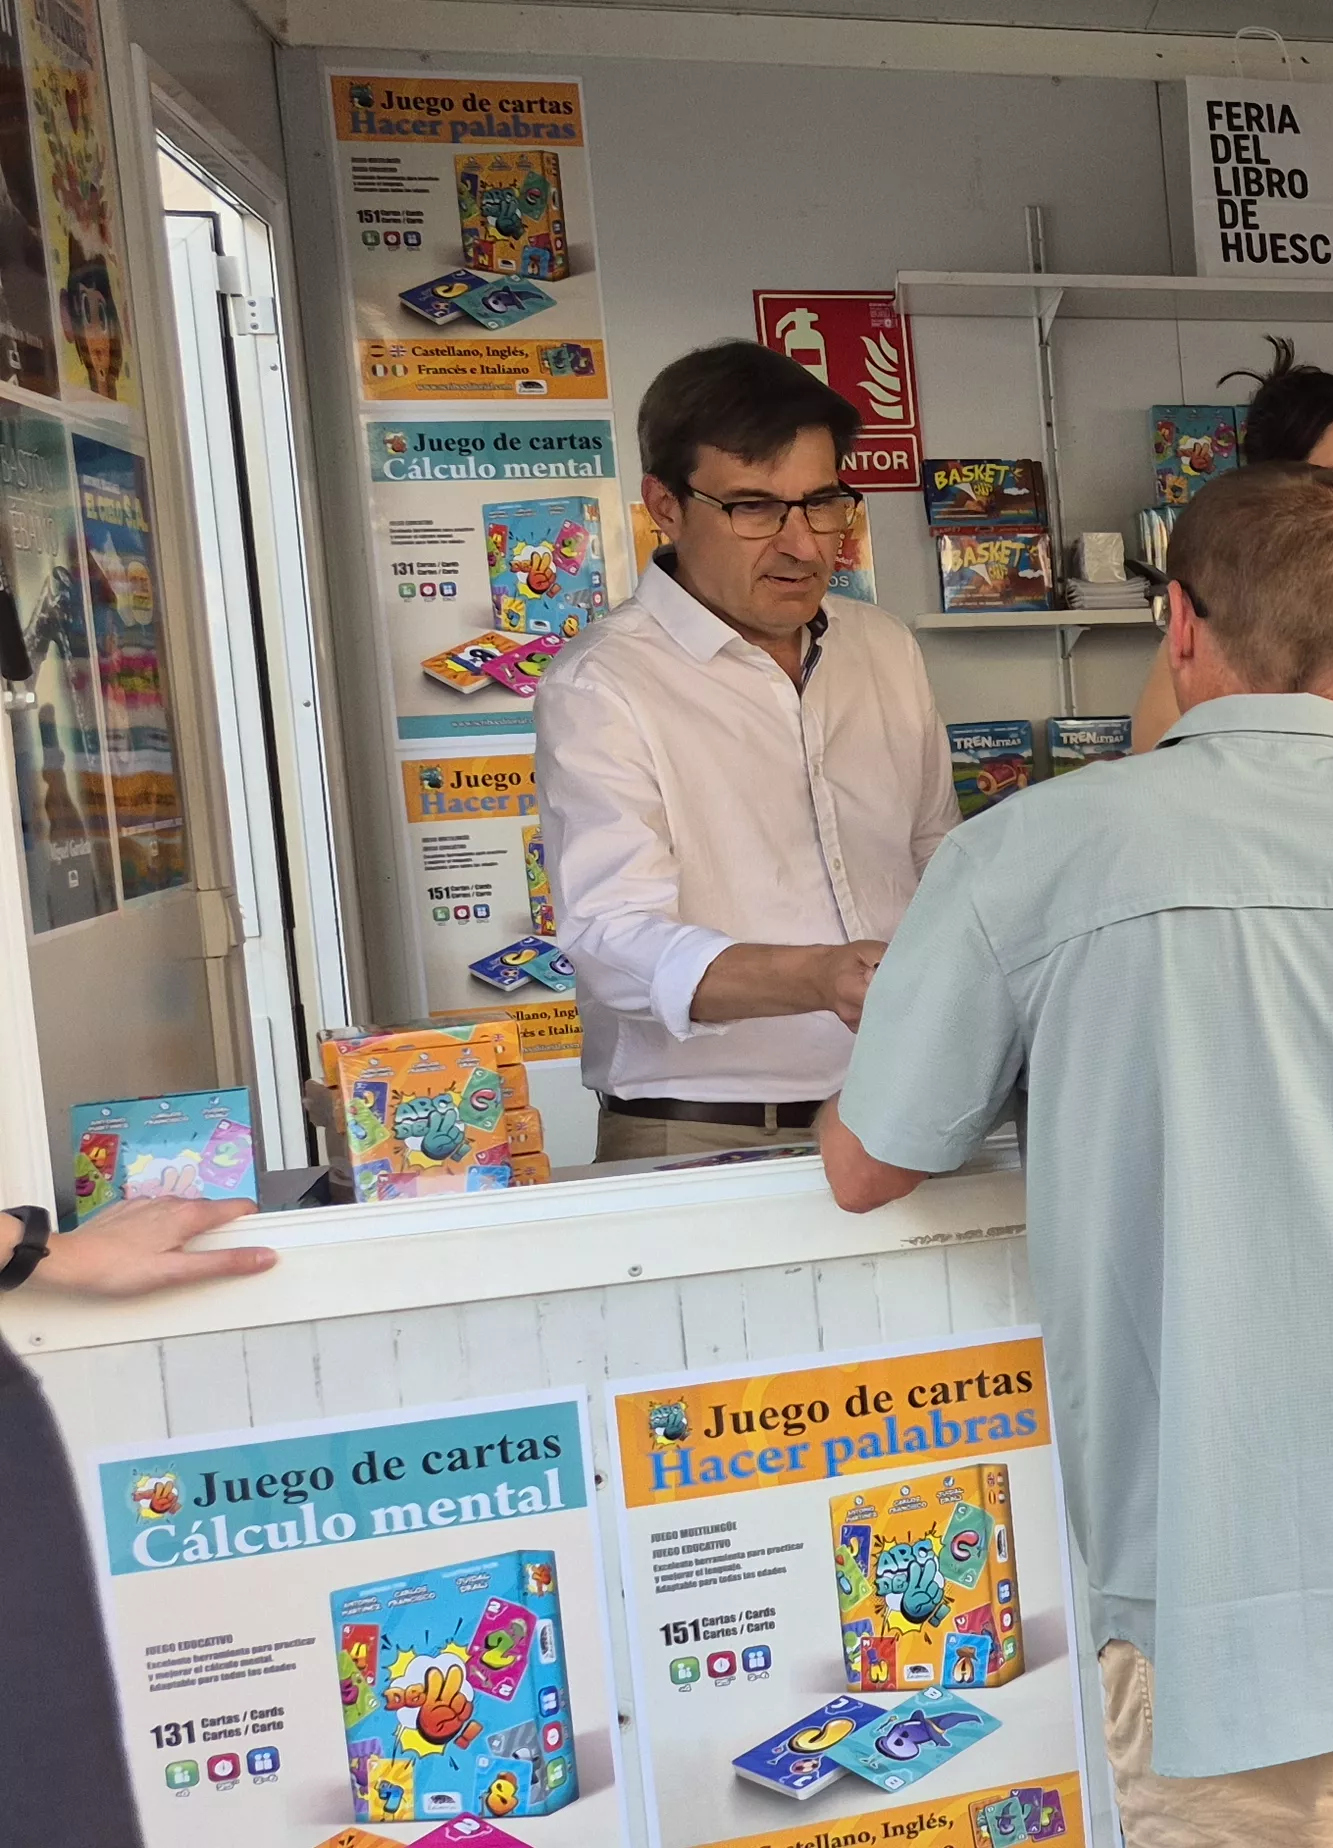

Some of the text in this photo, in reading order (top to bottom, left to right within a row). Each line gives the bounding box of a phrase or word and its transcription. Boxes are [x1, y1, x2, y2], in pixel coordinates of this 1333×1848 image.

[381, 90, 573, 115] Juego de cartas
[350, 111, 577, 143] Hacer palabras
[1206, 100, 1301, 134] FERIA
[1210, 133, 1271, 165] DEL
[1214, 166, 1309, 199] LIBRO
[356, 209, 380, 223] 151
[1217, 198, 1260, 230] DE
[411, 345, 529, 361] Castellano, Inglés,
[418, 363, 467, 375] Francés
[480, 364, 529, 375] Italiano
[413, 433, 602, 456] Juego de cartas
[383, 454, 604, 480] Cálculo mental
[841, 451, 909, 470] NTOR
[934, 463, 1009, 490] BASKET
[951, 540, 1026, 572] BASKET
[391, 562, 414, 576] 131
[953, 735, 994, 750] TREN
[1060, 731, 1097, 745] TREN
[451, 770, 521, 791] Juego
[420, 792, 509, 815] Hacer
[428, 886, 450, 900] 151
[553, 1006, 579, 1020] Ingl
[703, 1368, 1033, 1441] Juego de cartas
[646, 1407, 1039, 1491] Hacer palabras
[193, 1431, 562, 1507] Juego de cartas
[132, 1467, 566, 1569] Cálculo mental
[651, 1521, 737, 1543] JUEGO MULTILINGÜE
[652, 1538, 731, 1559] JUEGO EDUCATIVO
[767, 1542, 804, 1555] practicar
[877, 1538, 934, 1576] ABC
[702, 1606, 776, 1628] Cartas / Cards
[659, 1619, 701, 1647] 151
[702, 1620, 776, 1640] Cartes / Carte
[145, 1634, 233, 1656] JUEGO EDUCATIVO
[274, 1637, 316, 1652] practicar
[201, 1706, 285, 1728] Cartas / Cards
[150, 1720, 196, 1749] 131
[202, 1720, 284, 1742] Cartes / Carte
[881, 1813, 954, 1839] Inglés,
